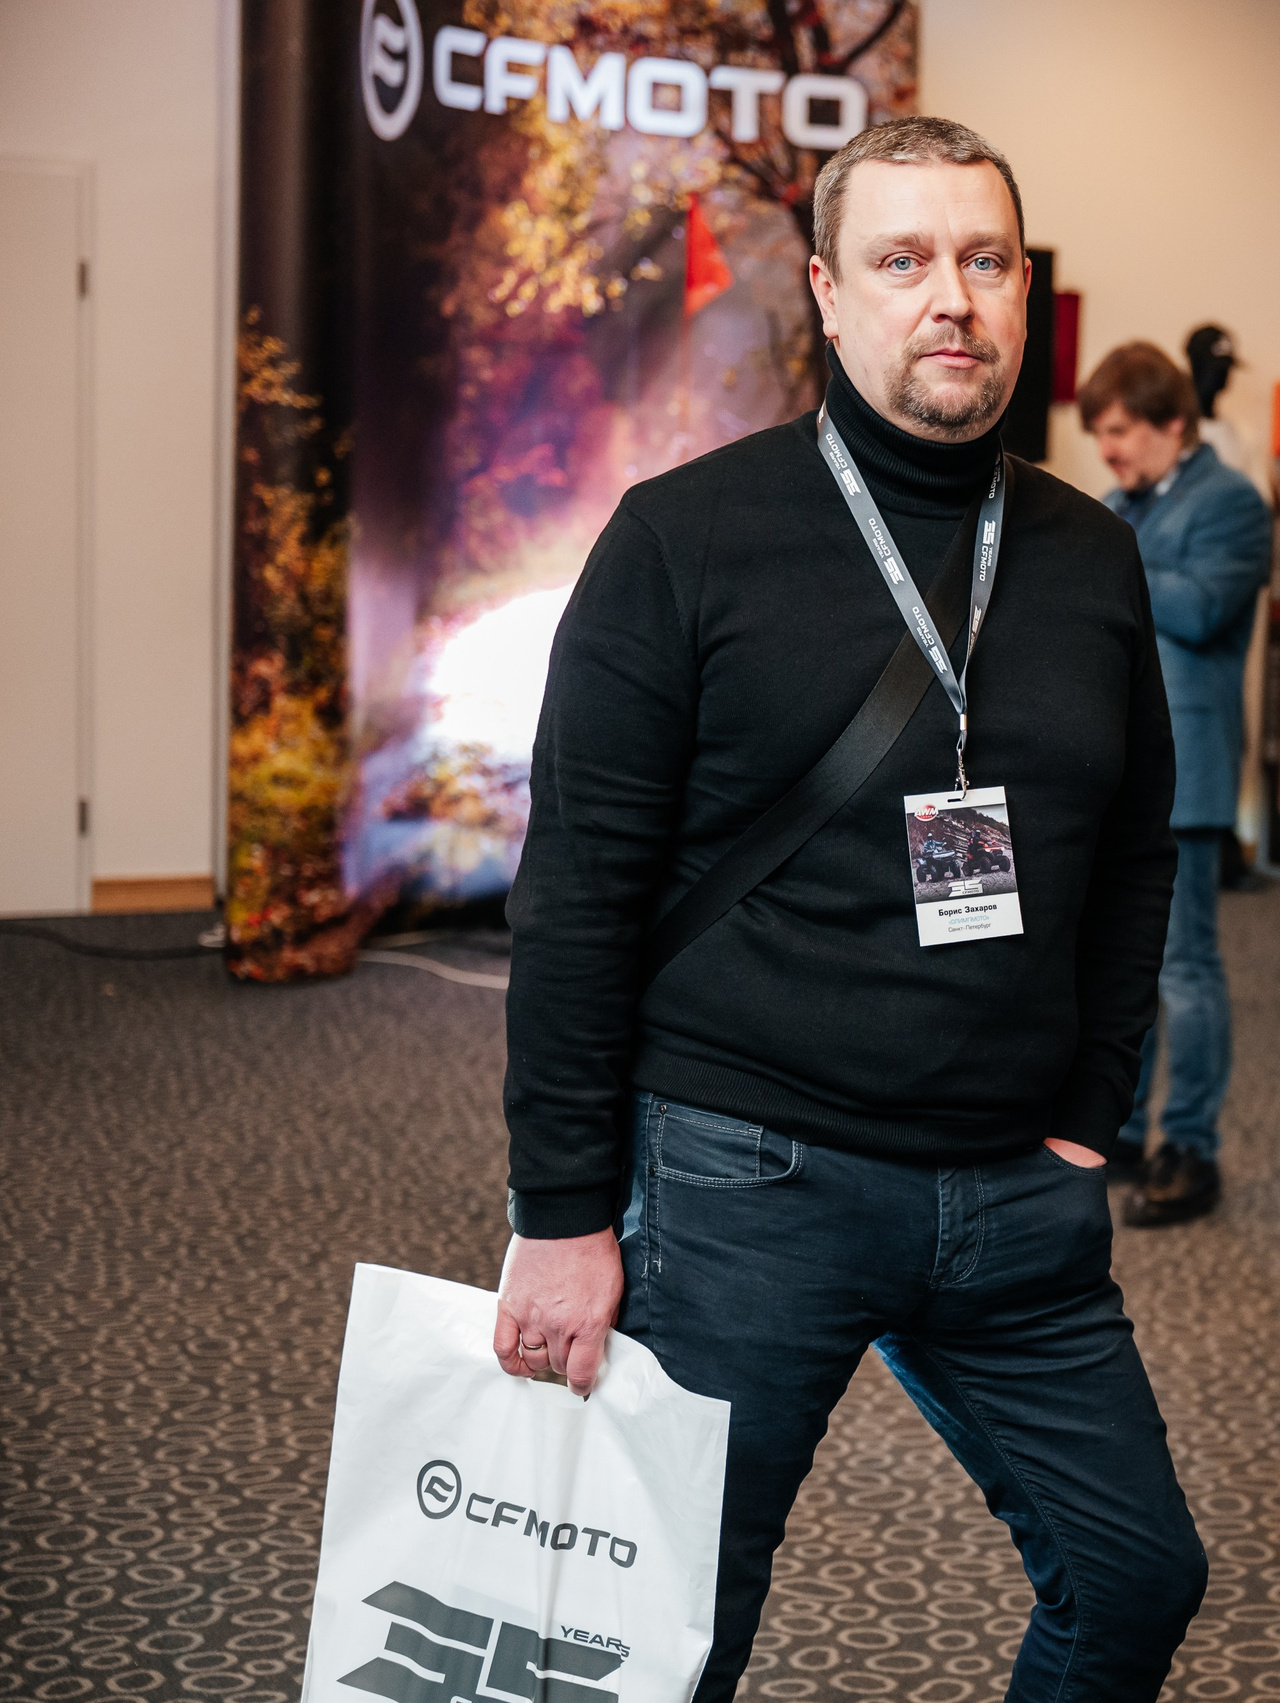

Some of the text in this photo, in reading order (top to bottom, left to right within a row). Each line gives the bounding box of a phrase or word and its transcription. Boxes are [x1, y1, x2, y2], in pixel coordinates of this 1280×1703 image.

[432, 25, 869, 150] CFMOTO
[825, 433, 848, 468] CFMOTO
[868, 517, 891, 556] CFMOTO
[979, 544, 989, 582] CFMOTO
[911, 606, 935, 645] CFMOTO
[938, 904, 997, 917] Борис Захаров
[465, 1492, 638, 1568] CFMOTO
[560, 1625, 631, 1658] YEARS
